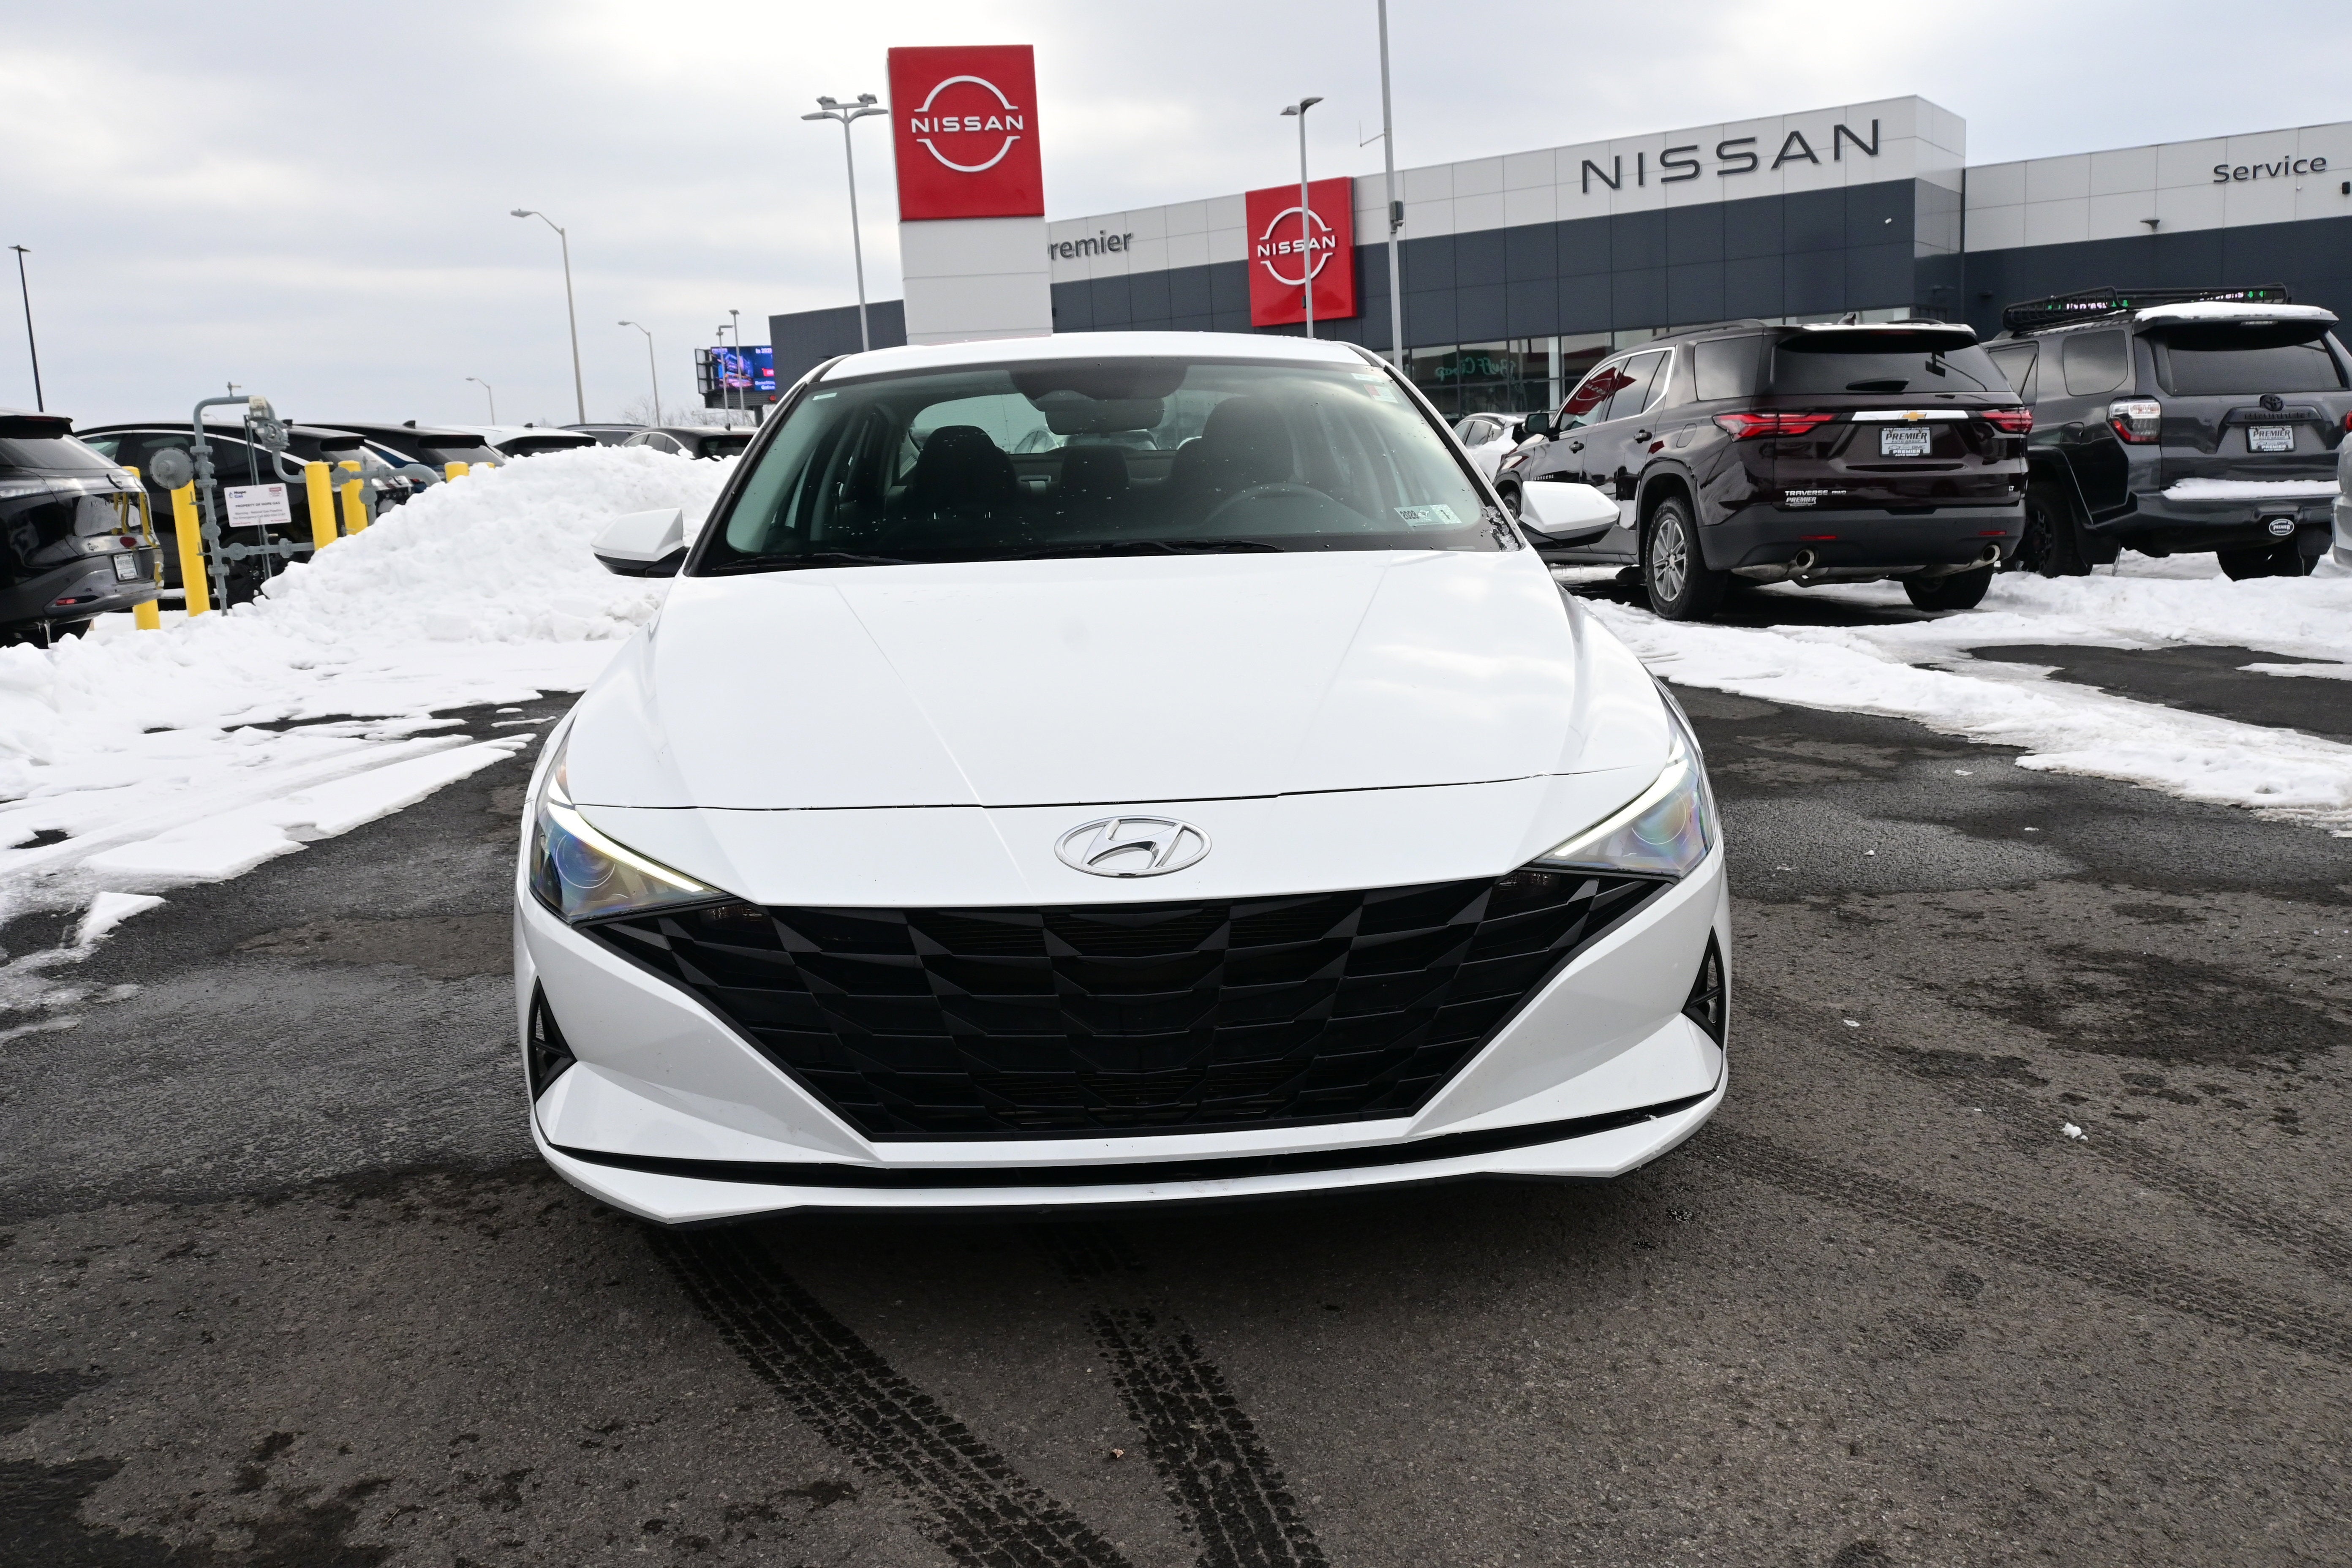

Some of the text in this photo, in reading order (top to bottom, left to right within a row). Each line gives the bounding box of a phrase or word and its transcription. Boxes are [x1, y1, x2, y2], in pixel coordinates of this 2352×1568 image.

[911, 115, 1024, 133] NISSAN
[1582, 119, 1881, 194] NISSAN
[2213, 155, 2327, 183] Service
[1048, 230, 1132, 260] remier
[1258, 235, 1336, 257] NISSAN
[1886, 432, 1927, 443] PREMIER
[2253, 430, 2290, 439] PREMIER
